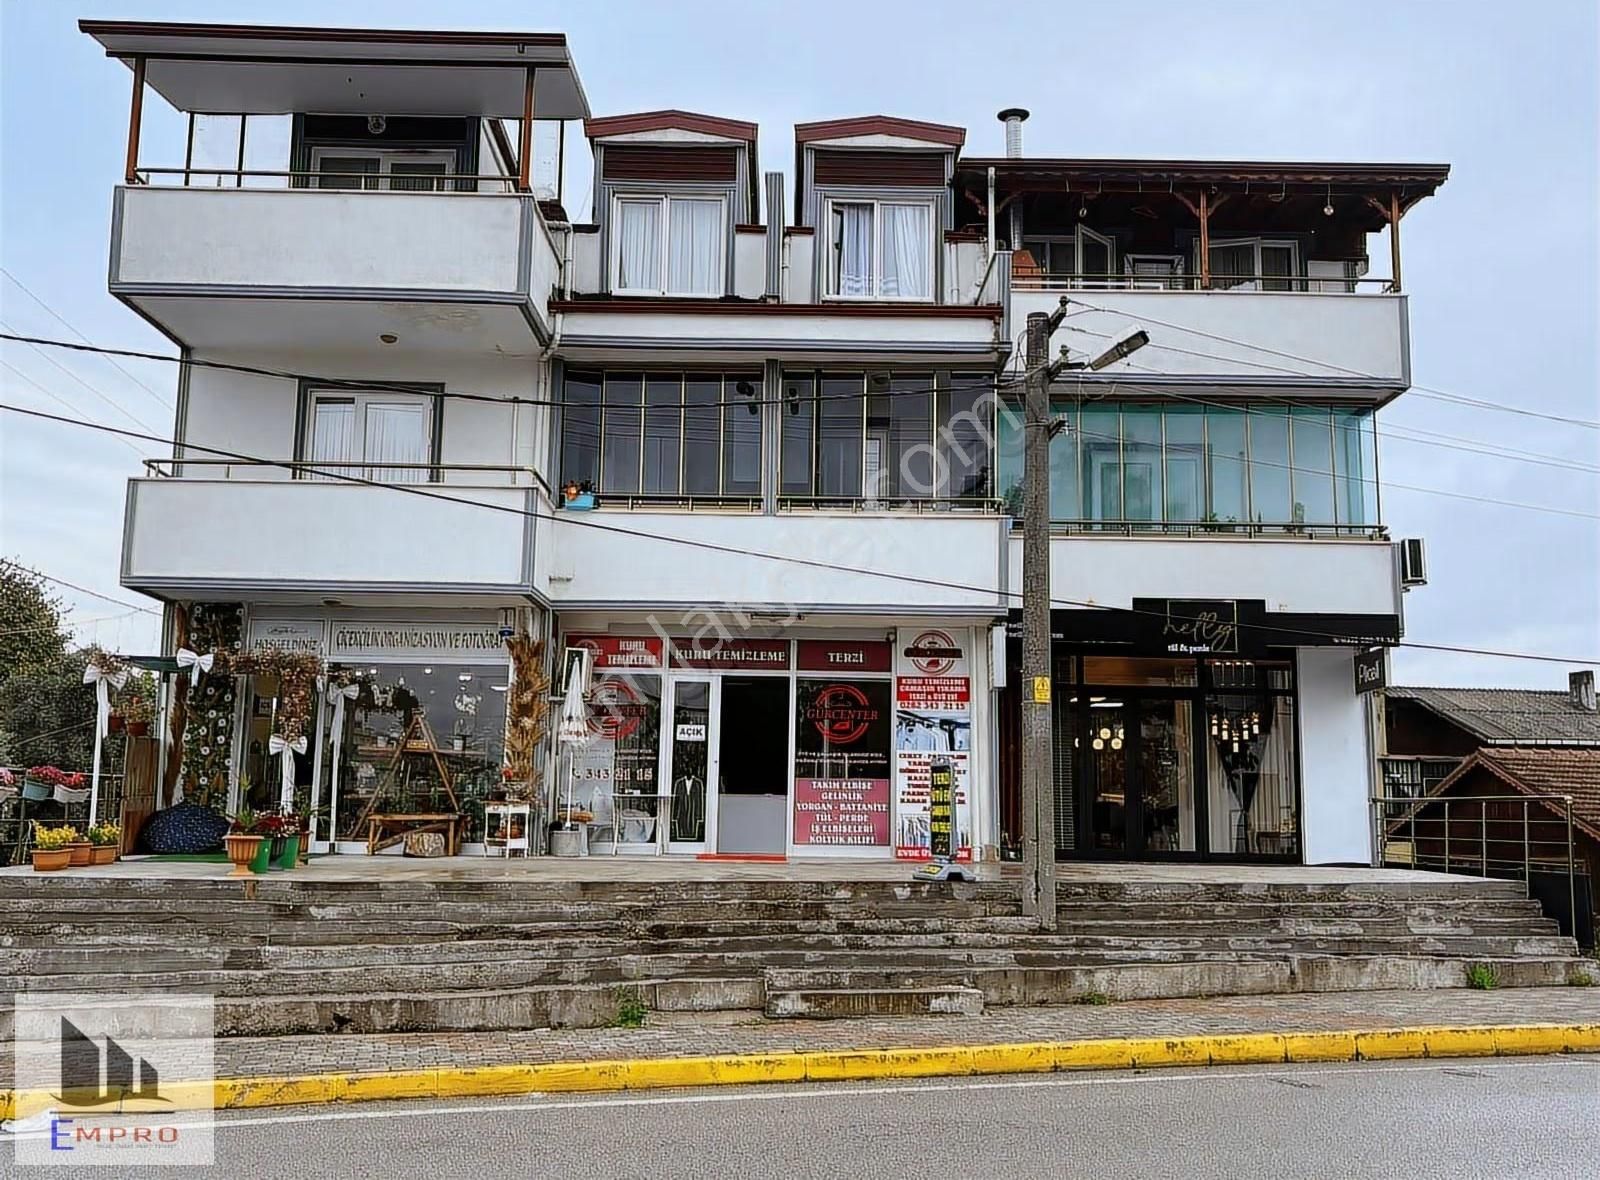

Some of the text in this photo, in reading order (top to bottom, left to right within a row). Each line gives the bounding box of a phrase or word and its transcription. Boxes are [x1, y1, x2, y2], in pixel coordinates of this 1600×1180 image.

[675, 647, 785, 662] KURU TEMİZLEME
[827, 650, 864, 663] TERZİ
[679, 727, 704, 737] AÇIK
